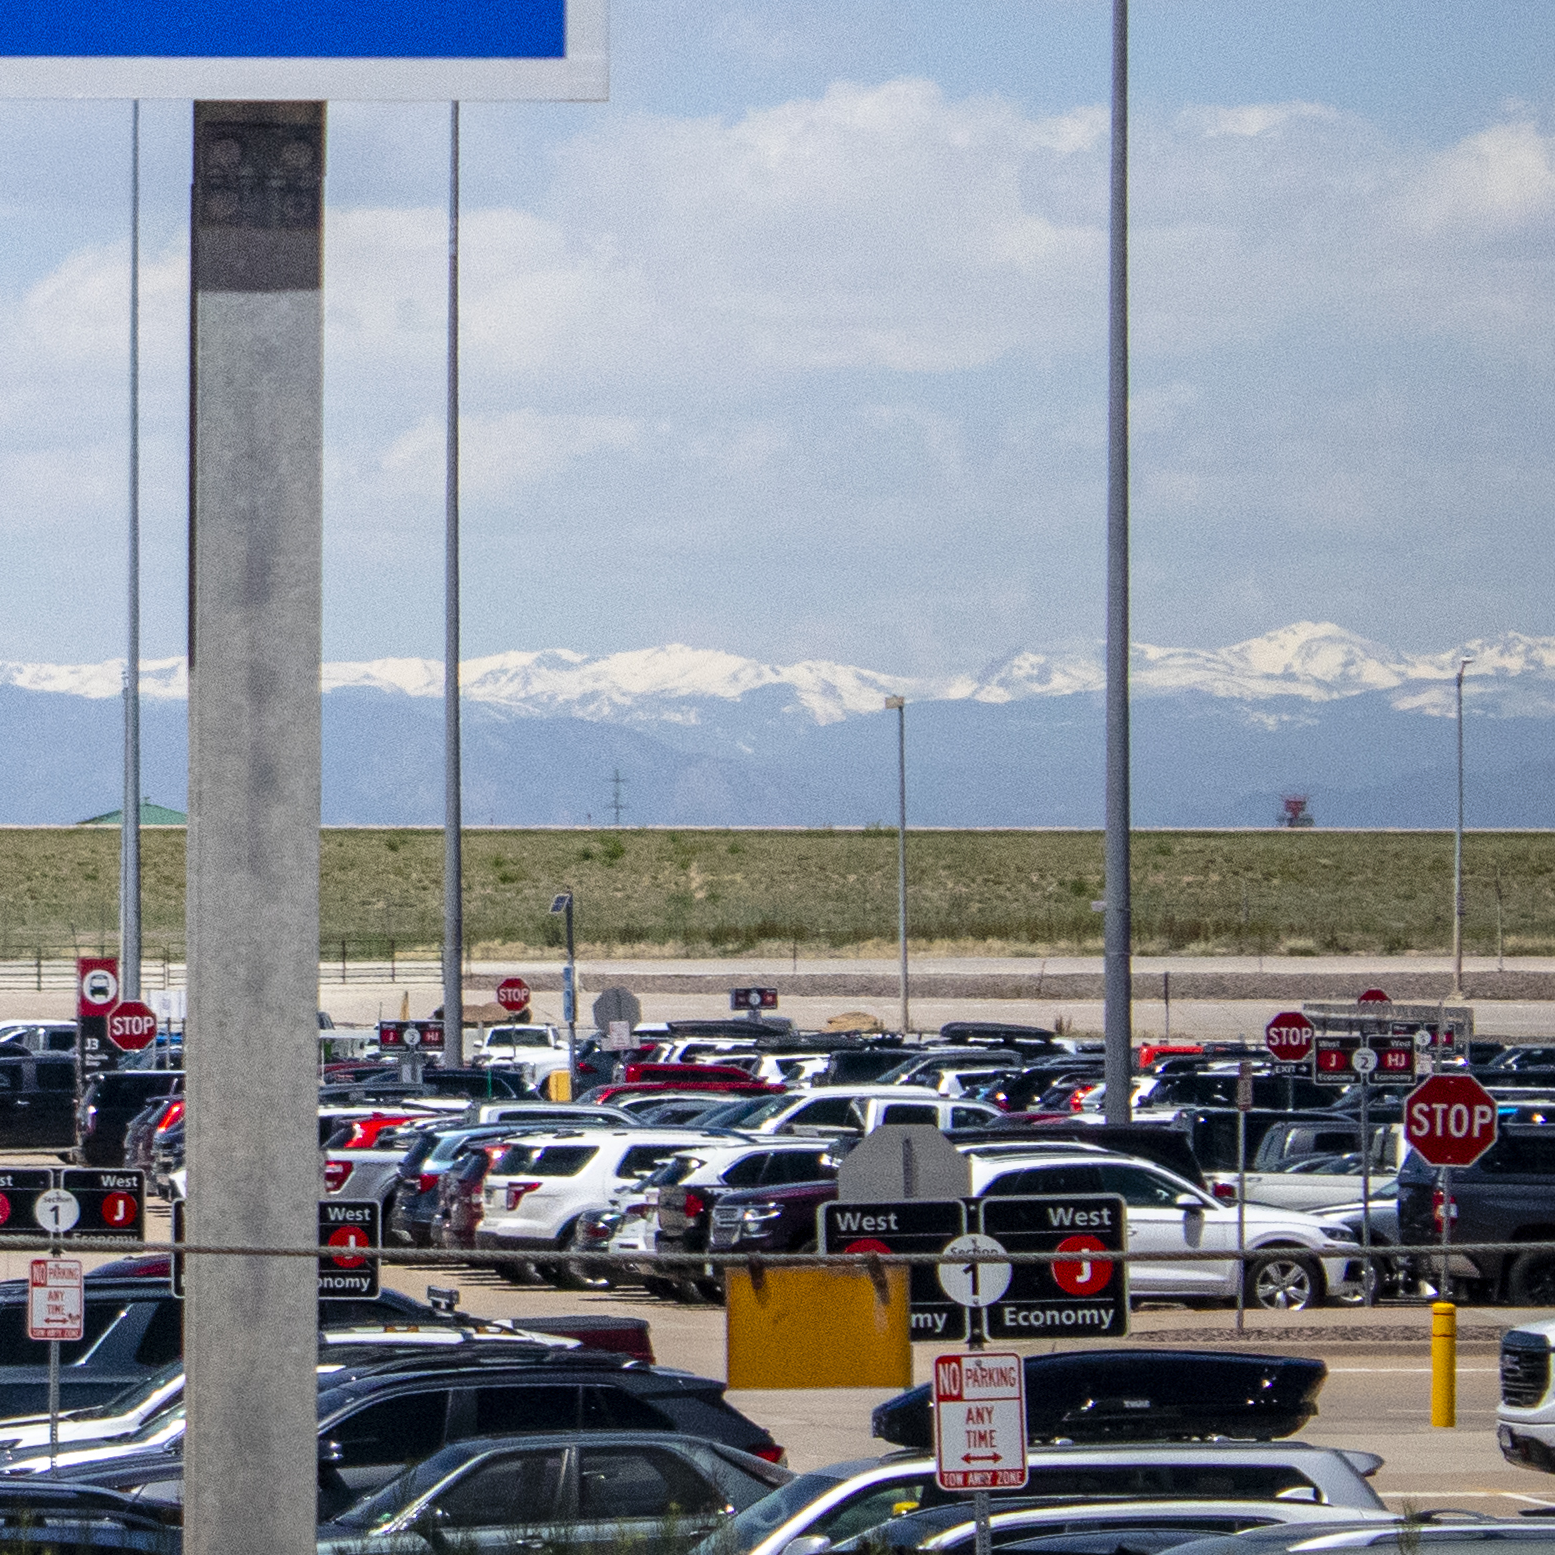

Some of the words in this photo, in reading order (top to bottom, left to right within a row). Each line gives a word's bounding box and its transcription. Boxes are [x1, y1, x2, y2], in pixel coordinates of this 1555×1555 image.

[498, 988, 529, 1002] STOP
[112, 1016, 154, 1035] STOP
[85, 1038, 99, 1050] J3
[1268, 1027, 1312, 1045] STOP
[1275, 1065, 1296, 1073] EXIT
[1330, 1054, 1337, 1067] J
[1360, 1057, 1368, 1069] 2
[1387, 1054, 1405, 1067] HJ
[1411, 1103, 1493, 1138] STOP
[100, 1175, 138, 1188] West
[43, 1195, 72, 1203] Section
[49, 1205, 59, 1225] 1
[113, 1200, 124, 1221] J
[328, 1207, 371, 1221] West
[1048, 1207, 1111, 1227] West
[836, 1212, 898, 1232] West
[345, 1234, 356, 1259] J
[950, 1246, 999, 1257] Section
[1075, 1247, 1091, 1283] J
[33, 1264, 46, 1286] NO
[49, 1267, 79, 1280] PARKING
[962, 1263, 978, 1296] 1
[47, 1291, 65, 1301] ANY
[47, 1304, 65, 1315] TIME
[1004, 1307, 1114, 1330] Economy
[938, 1362, 960, 1396] NO
[965, 1367, 1016, 1388] PARKING
[965, 1406, 994, 1425] ANY
[965, 1429, 997, 1449] TIME
[943, 1472, 964, 1486] TOW
[997, 1471, 1023, 1484] ZONE
